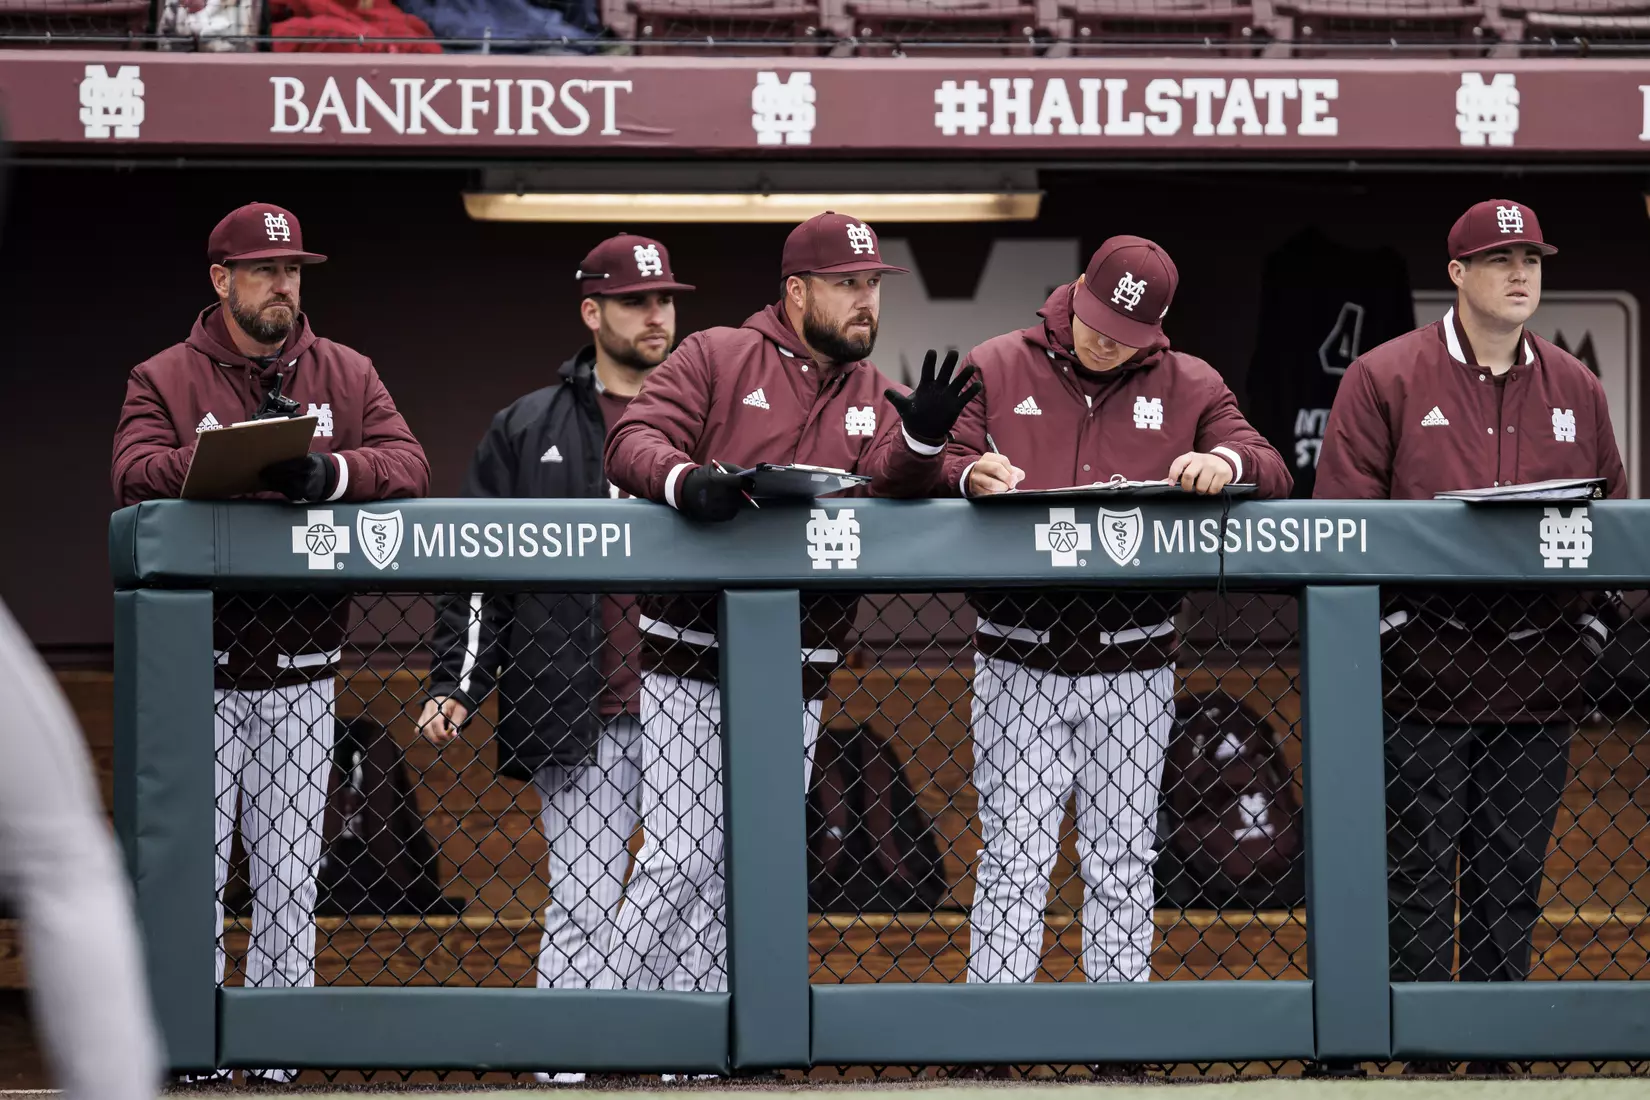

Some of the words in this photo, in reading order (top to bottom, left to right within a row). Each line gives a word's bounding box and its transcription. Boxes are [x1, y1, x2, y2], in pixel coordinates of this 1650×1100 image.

[270, 76, 633, 137] BANKFIRST
[934, 78, 1339, 138] #HAILSTATE
[742, 397, 770, 410] adidas
[1013, 406, 1042, 416] adidas
[1420, 418, 1450, 427] adidas
[413, 522, 631, 559] MISSISSIPPI
[1153, 517, 1367, 555] MISSISSIPPI
